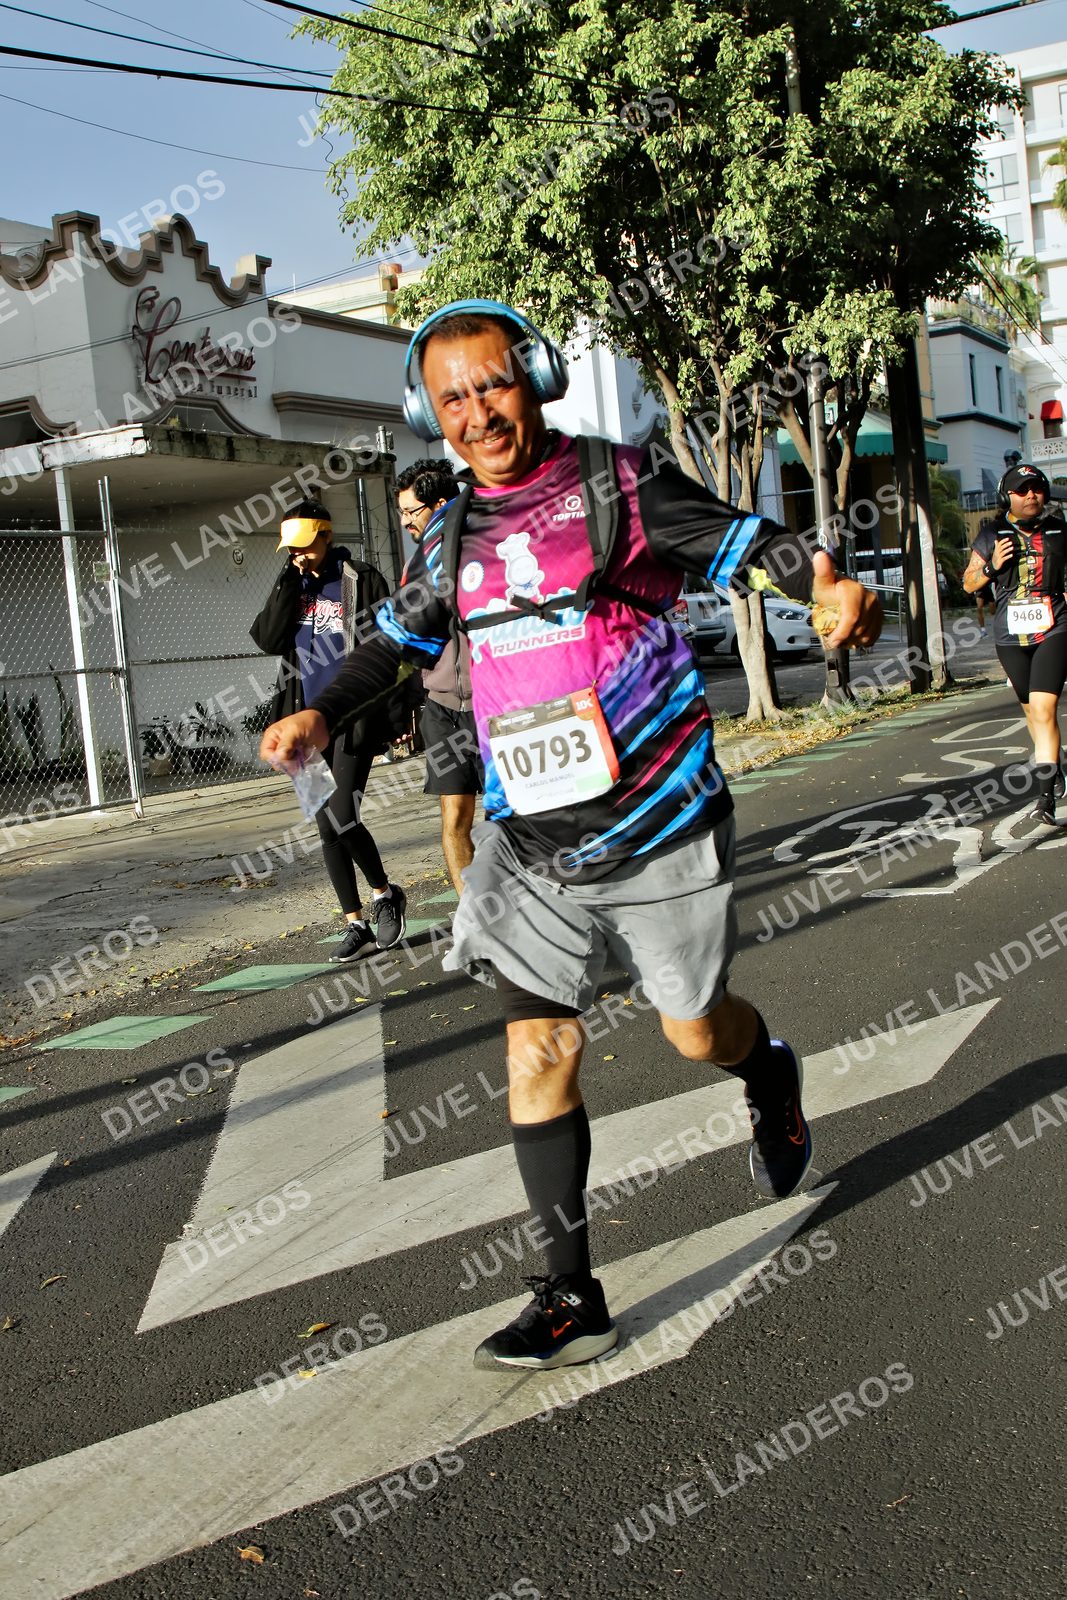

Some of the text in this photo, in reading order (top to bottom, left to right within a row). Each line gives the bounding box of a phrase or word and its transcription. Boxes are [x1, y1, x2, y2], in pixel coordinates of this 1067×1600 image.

[1013, 608, 1042, 621] 9468
[494, 626, 583, 655] RUNNERS
[497, 729, 592, 781] 10793
